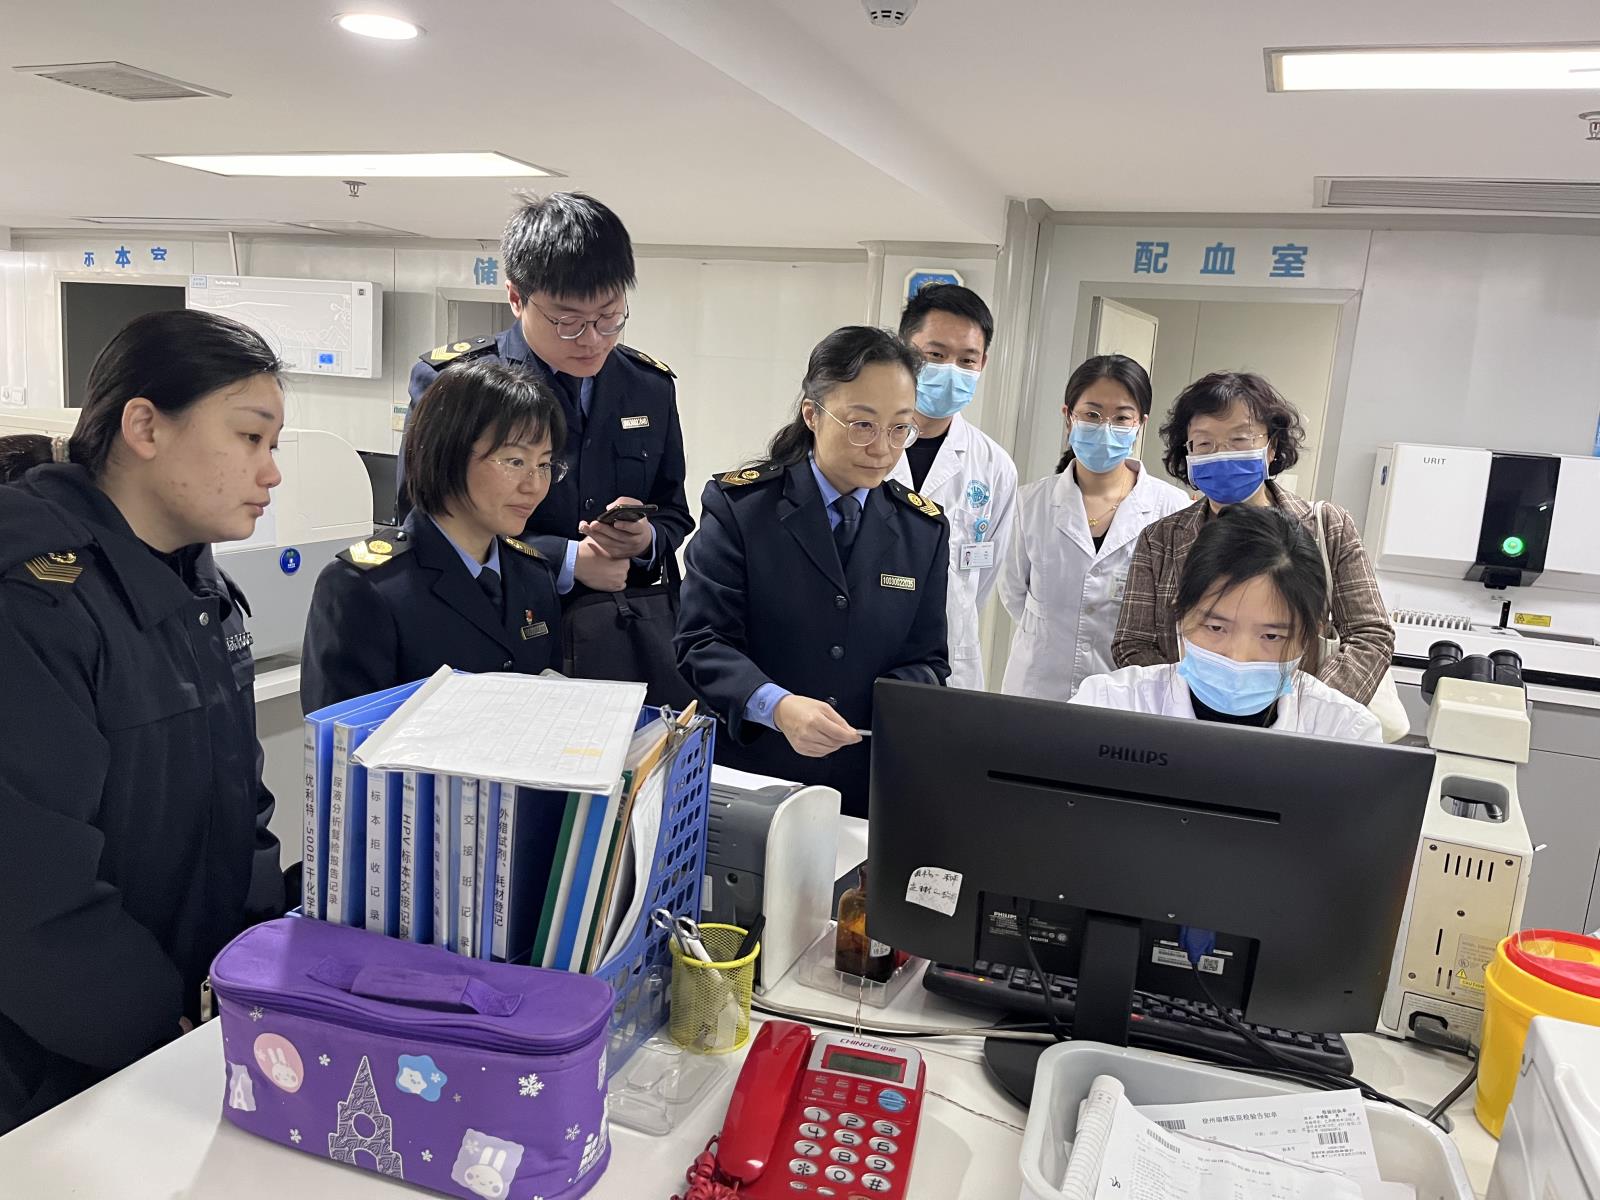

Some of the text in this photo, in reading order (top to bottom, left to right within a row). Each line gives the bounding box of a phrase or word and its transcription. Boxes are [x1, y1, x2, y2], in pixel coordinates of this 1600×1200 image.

[473, 256, 499, 285] 储
[1133, 241, 1308, 278] 配血室
[1423, 456, 1447, 465] URIT
[1098, 744, 1169, 767] PHILIPS
[369, 789, 381, 921] 标本拒收记录
[846, 1116, 858, 1127] 2
[880, 1123, 893, 1135] 3
[808, 1126, 890, 1152] 4 5 6
[804, 1144, 886, 1170] 7 8 9
